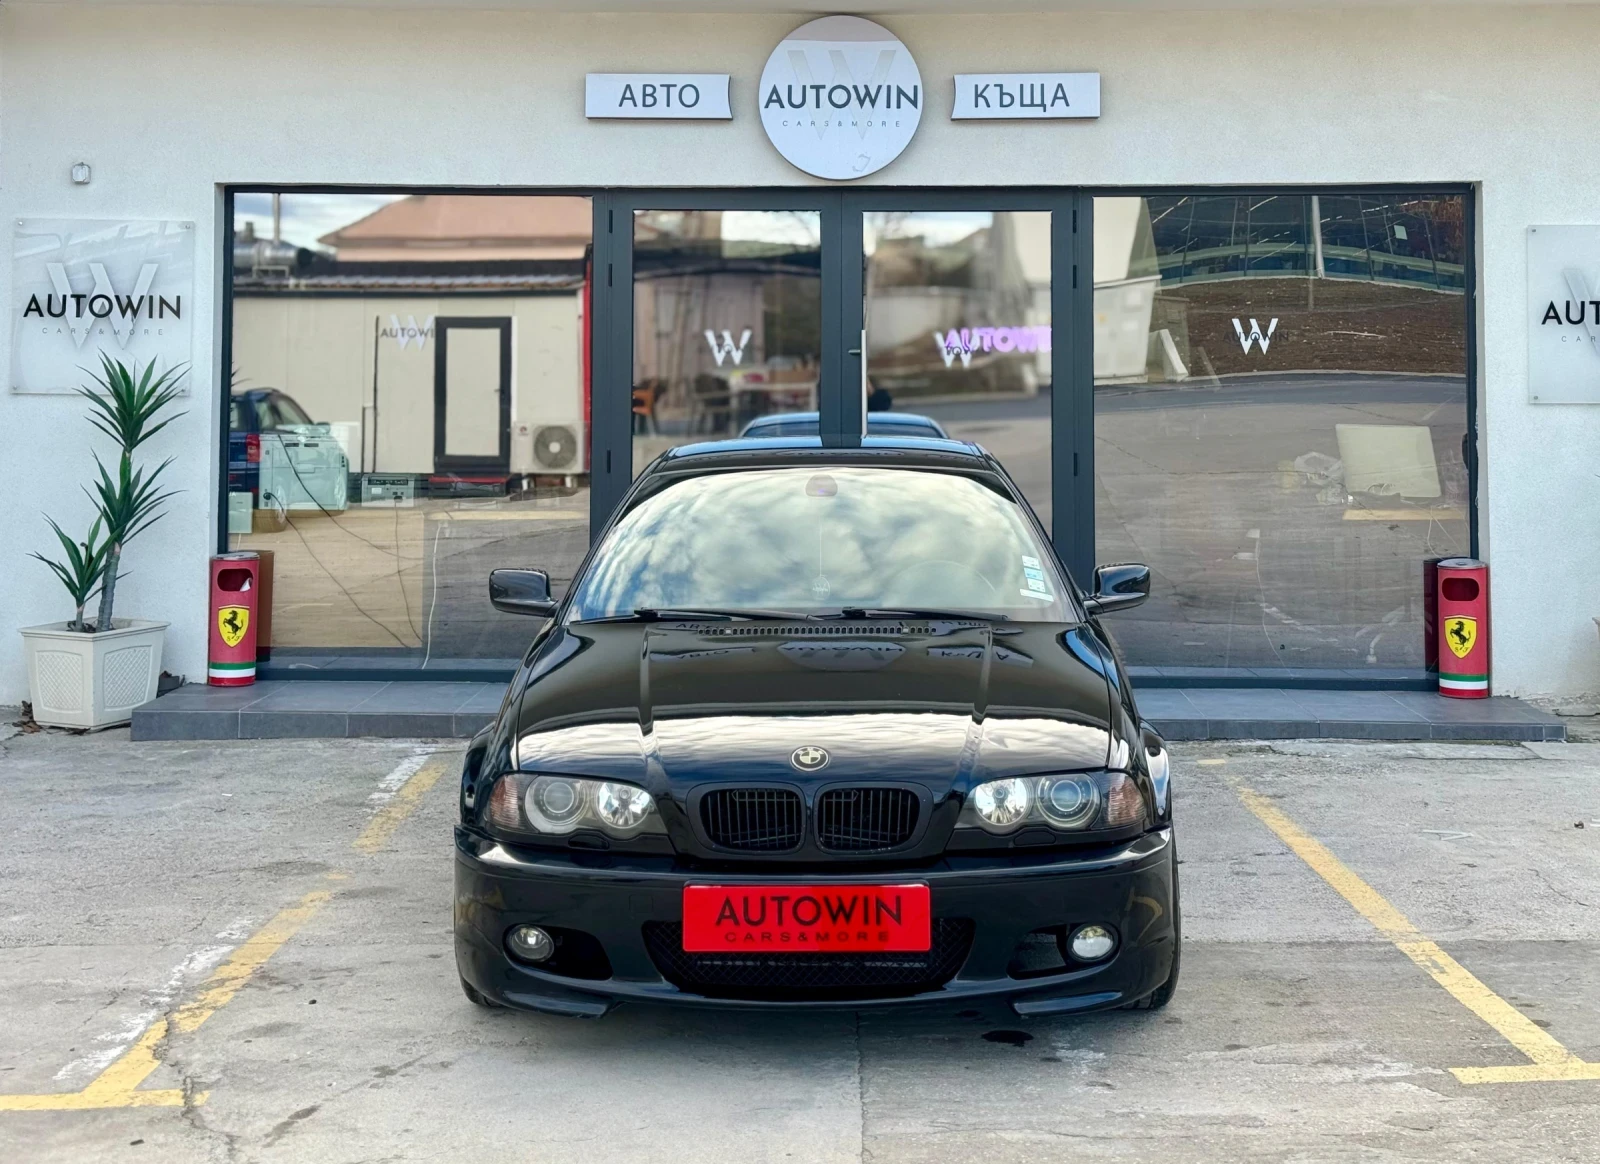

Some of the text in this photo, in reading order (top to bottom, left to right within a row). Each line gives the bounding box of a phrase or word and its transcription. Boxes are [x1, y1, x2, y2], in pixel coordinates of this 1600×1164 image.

[618, 83, 701, 109] АВТО
[764, 84, 918, 109] AUTOWIN
[974, 82, 1070, 113] КЪЩА
[782, 120, 901, 128] CARS&MORE
[23, 293, 181, 320] AUTOWIN
[42, 327, 163, 336] CARS&MORE
[380, 328, 435, 339] AUTOWI
[715, 896, 902, 926] AUTOWIN
[724, 931, 889, 942] CARS&MORE
